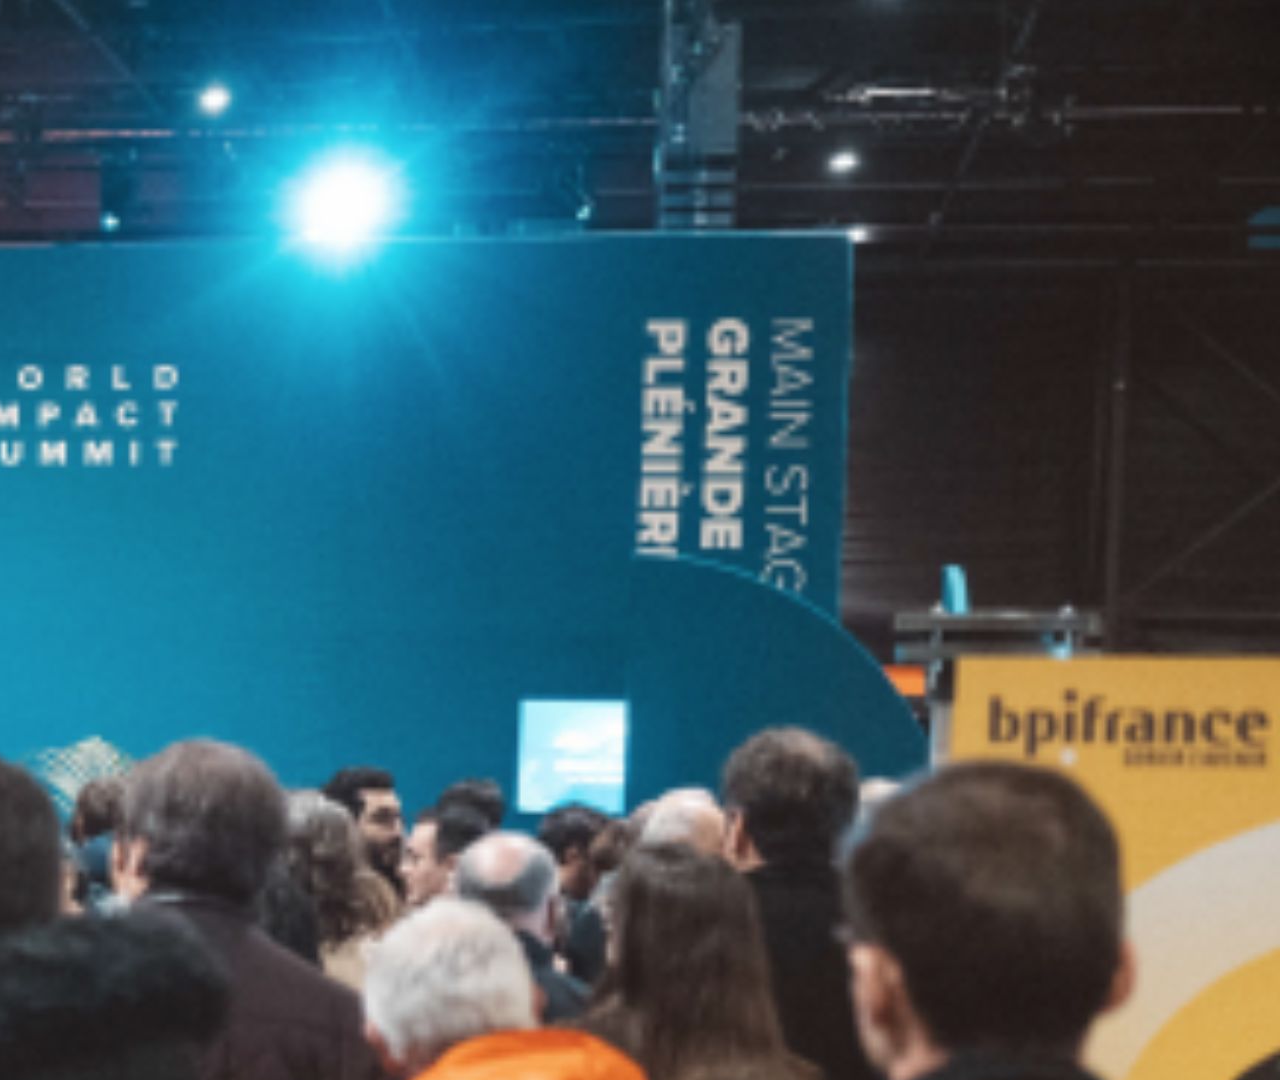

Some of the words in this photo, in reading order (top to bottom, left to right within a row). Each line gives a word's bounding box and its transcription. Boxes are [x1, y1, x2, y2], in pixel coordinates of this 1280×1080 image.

[634, 316, 696, 561] PLÉNIÈR
[698, 316, 751, 551] GRANDE
[767, 316, 814, 449] MAIN
[757, 463, 810, 592] STAG
[987, 688, 1270, 757] bpifrance
